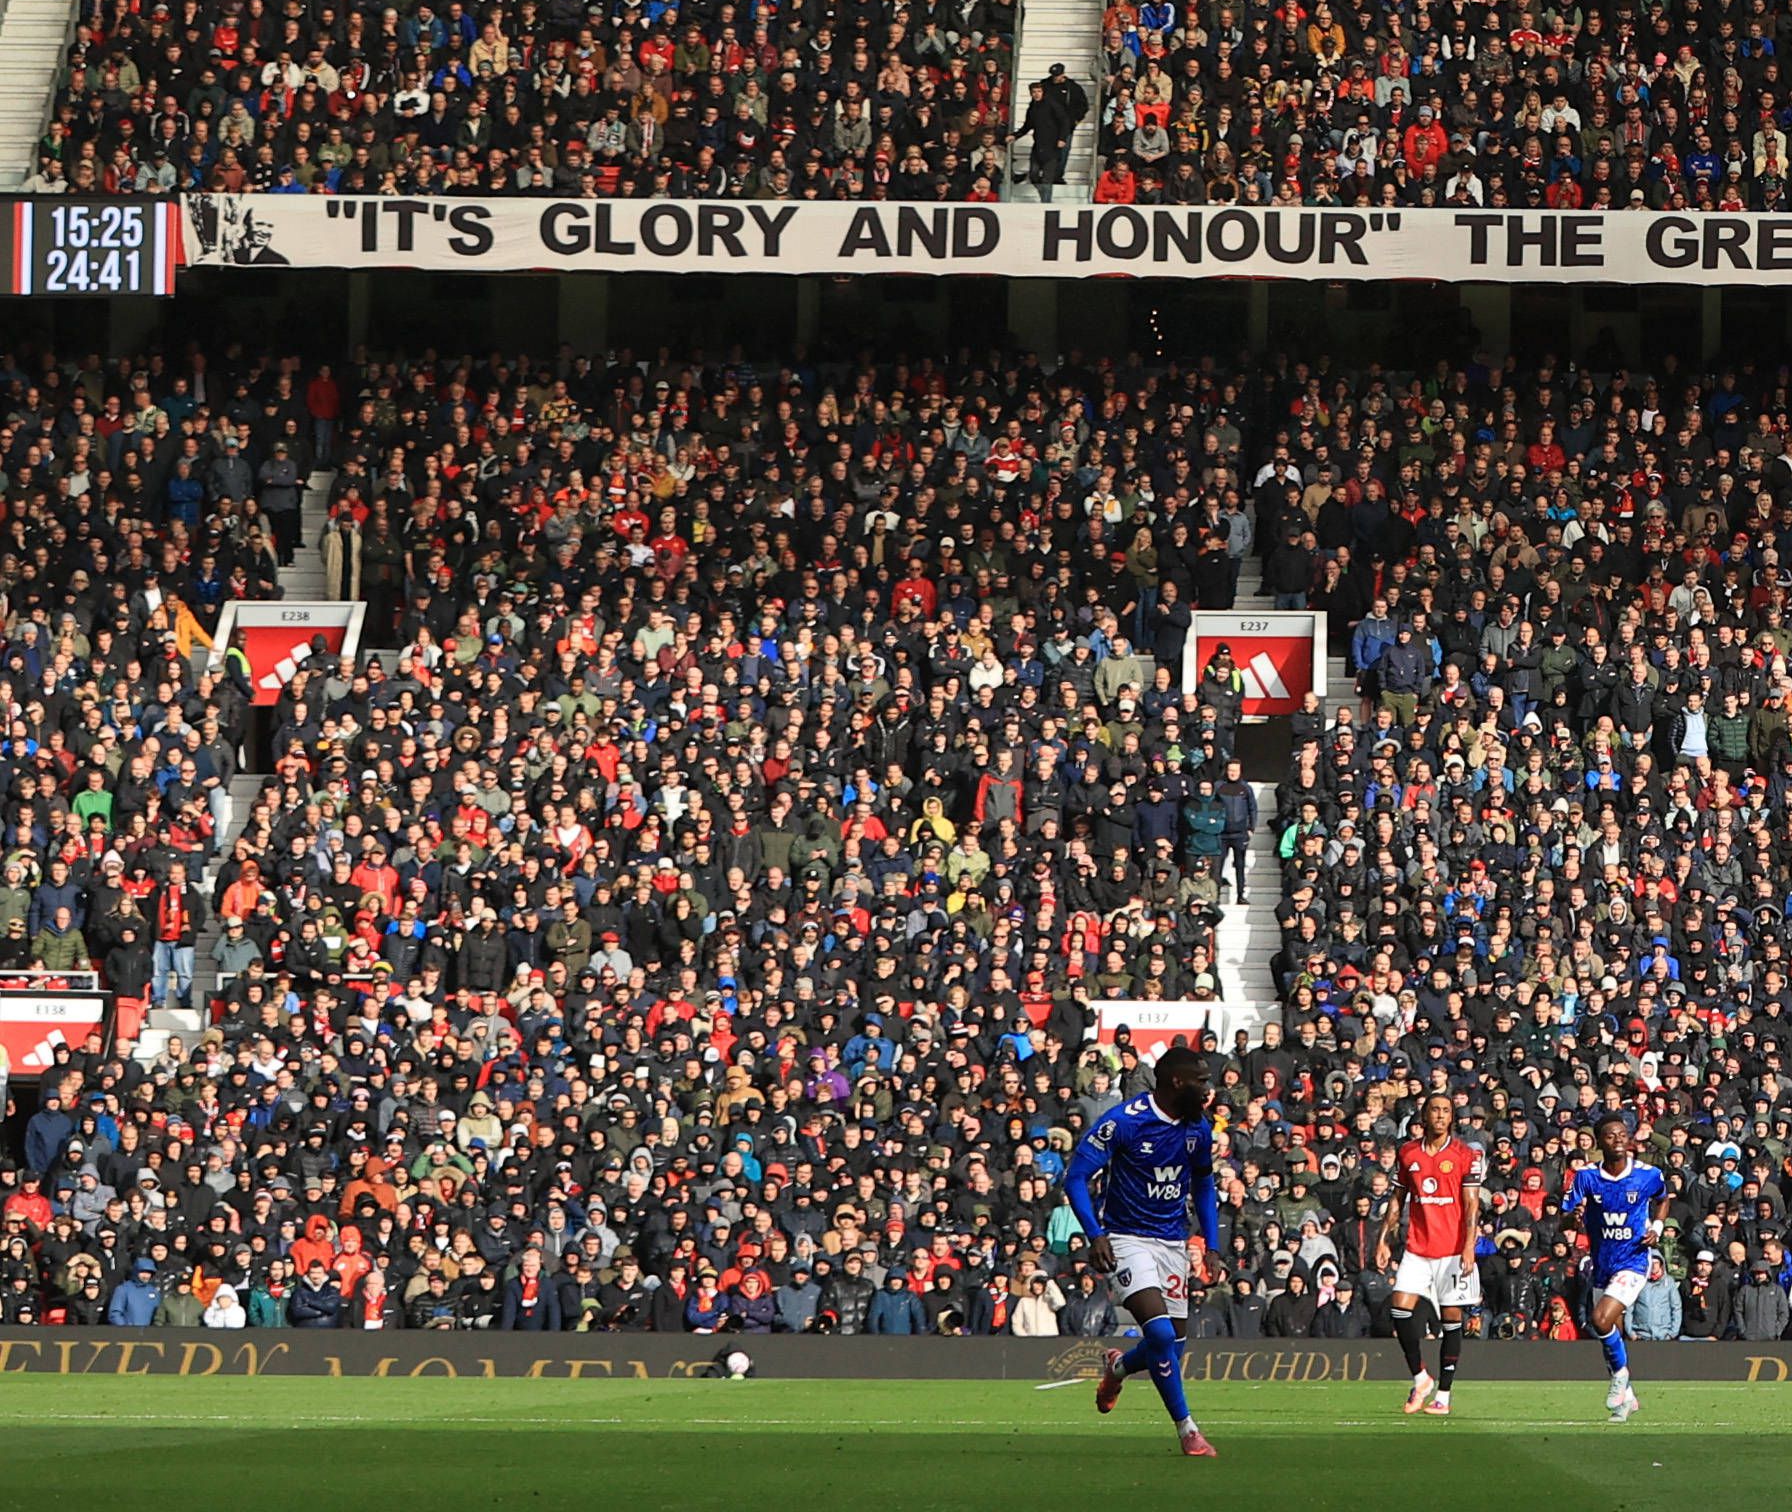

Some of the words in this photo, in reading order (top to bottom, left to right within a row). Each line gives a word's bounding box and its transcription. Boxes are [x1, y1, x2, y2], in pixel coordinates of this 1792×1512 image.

[51, 206, 143, 249] 15:25
[327, 200, 493, 256] "IT'S
[540, 203, 799, 257] GLORY
[838, 206, 1000, 259] AND
[1043, 206, 1400, 265] HONOUR"
[1455, 214, 1604, 267] THE
[46, 251, 143, 292] 24:41
[281, 611, 310, 622] E238
[1240, 623, 1269, 633] E237
[35, 1005, 66, 1016] E138
[1138, 1013, 1169, 1023] E137
[1601, 1227, 1633, 1241] W88
[1450, 1273, 1470, 1291] 15
